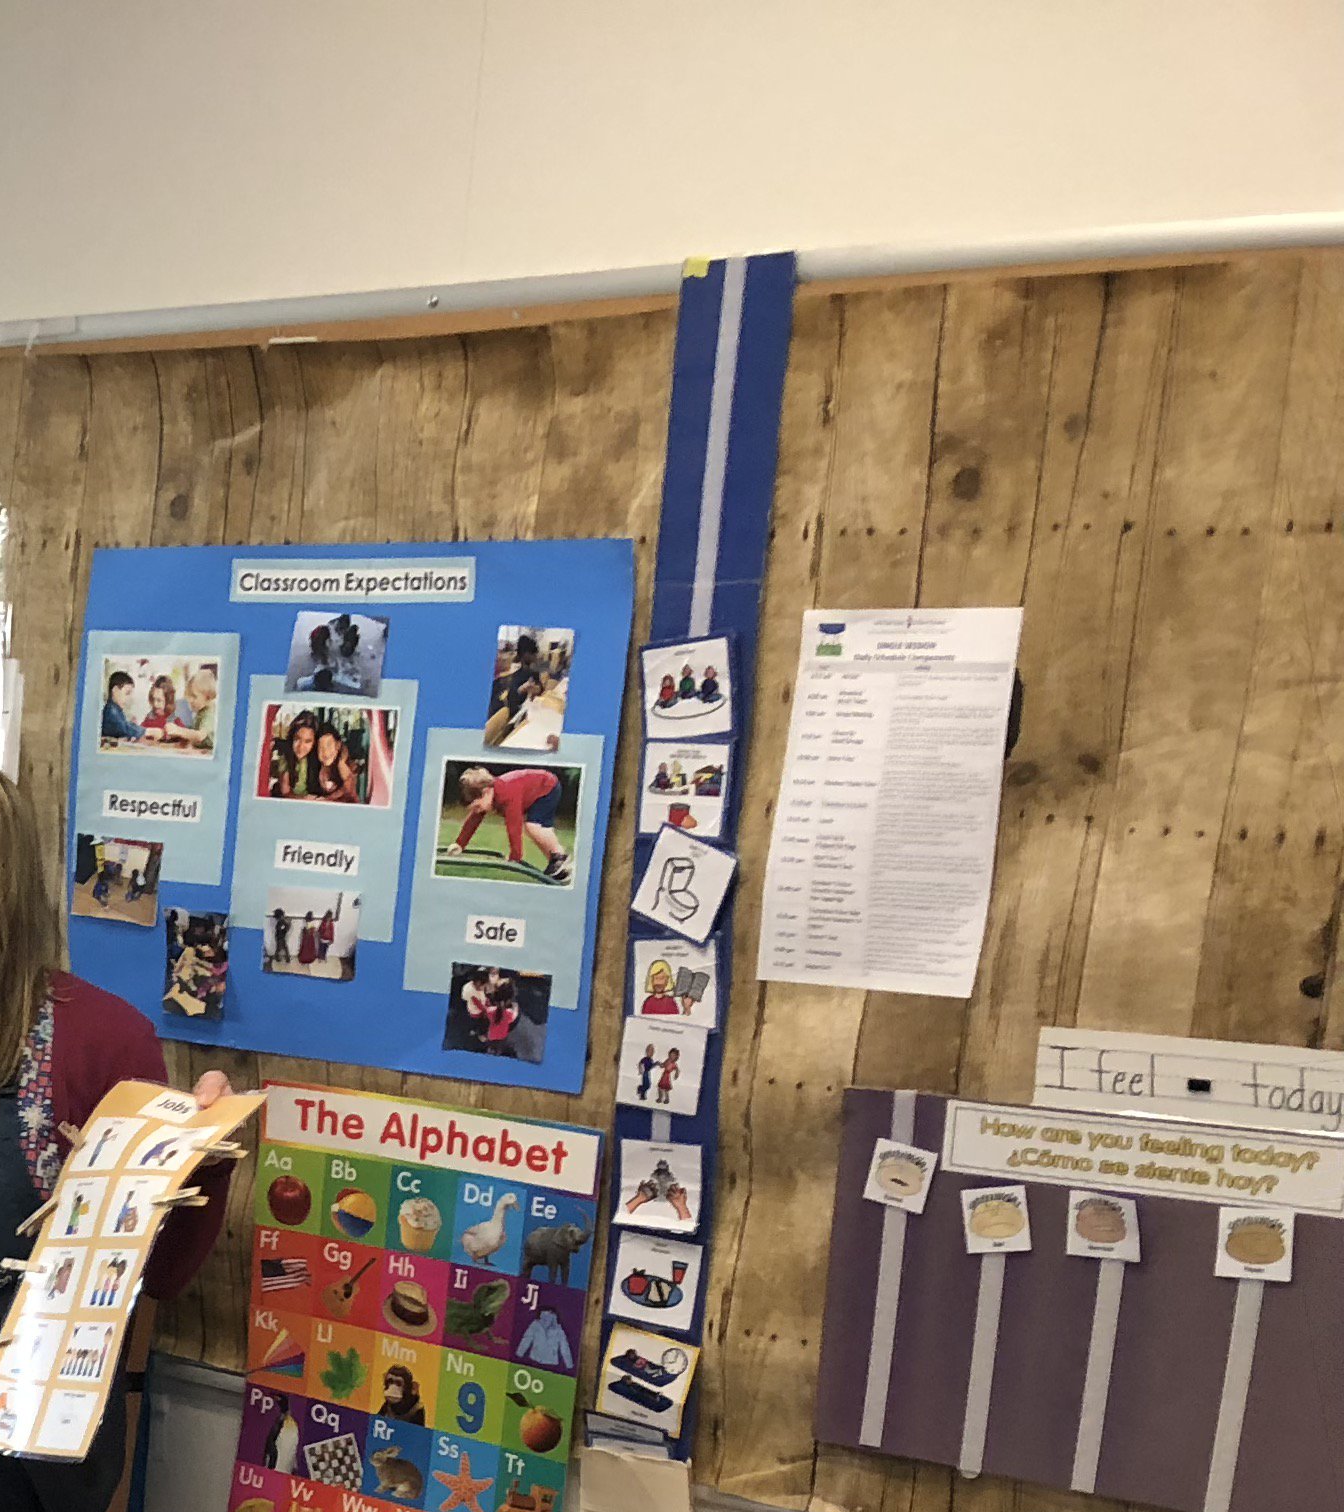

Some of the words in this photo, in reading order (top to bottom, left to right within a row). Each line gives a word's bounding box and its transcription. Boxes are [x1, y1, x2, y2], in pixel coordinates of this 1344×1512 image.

[239, 572, 340, 592] Classroom
[345, 570, 468, 595] Expectations
[109, 794, 197, 818] Respectful
[281, 845, 355, 873] Friendly
[473, 919, 518, 943] Safe
[1045, 1046, 1080, 1090] I
[1090, 1049, 1156, 1098] feel
[1242, 1062, 1344, 1131] today
[156, 1099, 192, 1114] Jobs
[294, 1098, 365, 1140] The
[379, 1111, 569, 1175] Alphabet
[980, 1115, 1034, 1138] How
[1040, 1126, 1083, 1145] are
[1088, 1130, 1133, 1151] you
[1139, 1132, 1225, 1164] feeling
[1231, 1143, 1321, 1173] today?
[264, 1150, 293, 1171] Aa
[331, 1159, 357, 1181] Bb
[396, 1172, 422, 1194] Cc
[1098, 1157, 1129, 1175] se
[1135, 1161, 1211, 1186] siente
[1217, 1169, 1280, 1196] hoy?
[464, 1183, 493, 1207] Dd
[531, 1196, 558, 1220] Ee
[260, 1230, 280, 1250] Ff
[323, 1242, 353, 1270] Gg
[388, 1255, 416, 1278] Hh
[453, 1268, 468, 1290] Ii
[521, 1283, 540, 1311] Jj
[255, 1310, 279, 1332] Kk
[317, 1323, 333, 1343] Ll
[381, 1338, 417, 1363] Mm
[446, 1353, 475, 1377] Nn
[514, 1369, 544, 1393] Oo
[250, 1388, 275, 1413] Pp
[457, 1381, 486, 1434] 9
[311, 1404, 340, 1433] Qq
[373, 1419, 395, 1441] Rr
[437, 1435, 459, 1459] Ss
[504, 1452, 525, 1476] Tt
[238, 1465, 264, 1489] Uu
[290, 1479, 314, 1501] Vv
